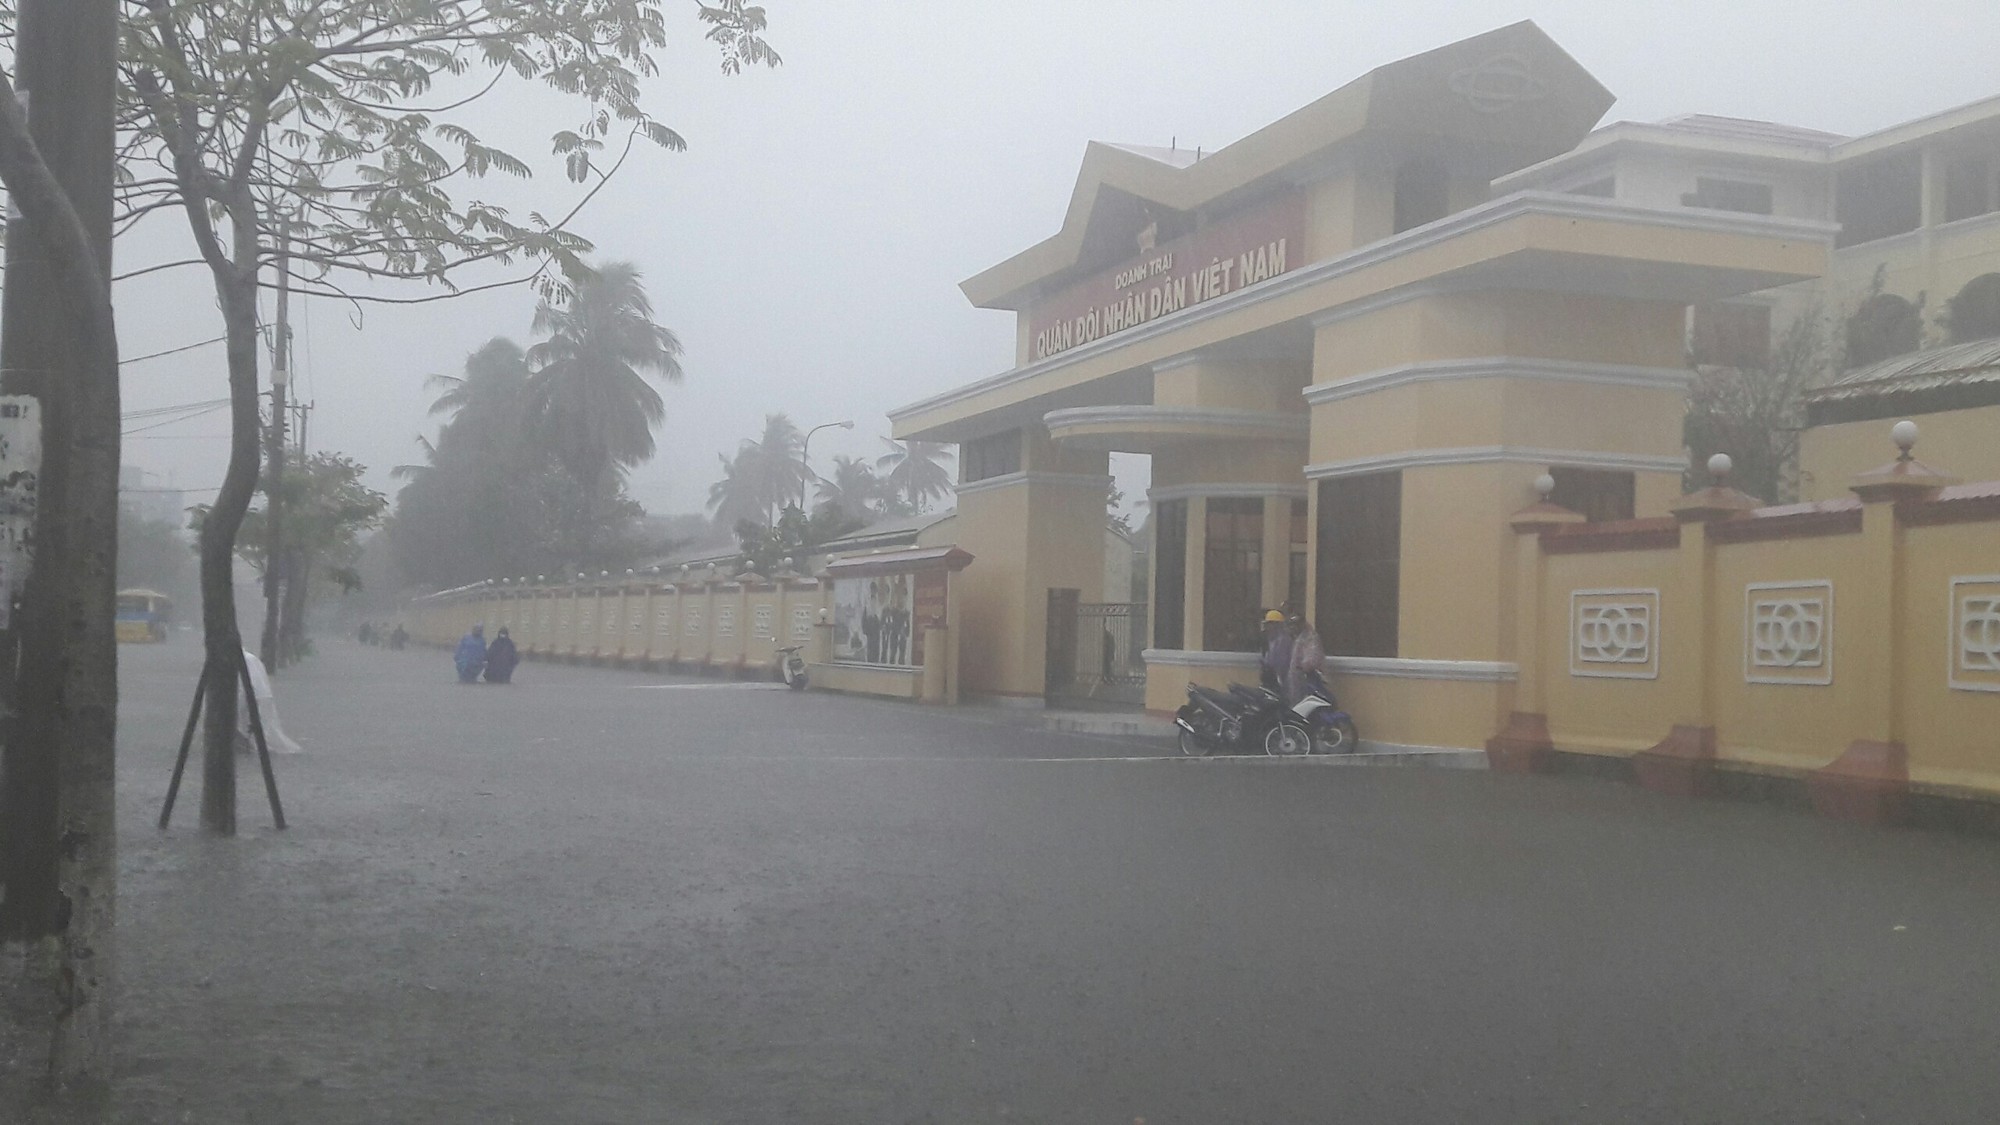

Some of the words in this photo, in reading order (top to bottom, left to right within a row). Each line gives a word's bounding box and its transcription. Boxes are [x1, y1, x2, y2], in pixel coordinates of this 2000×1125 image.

[1037, 319, 1072, 360] QUÂN
[1103, 292, 1146, 336] NHÂN
[1150, 275, 1186, 319] DÂN
[1240, 238, 1286, 288] NAM
[1115, 263, 1147, 290] DOANH
[1149, 253, 1173, 275] TRẠI
